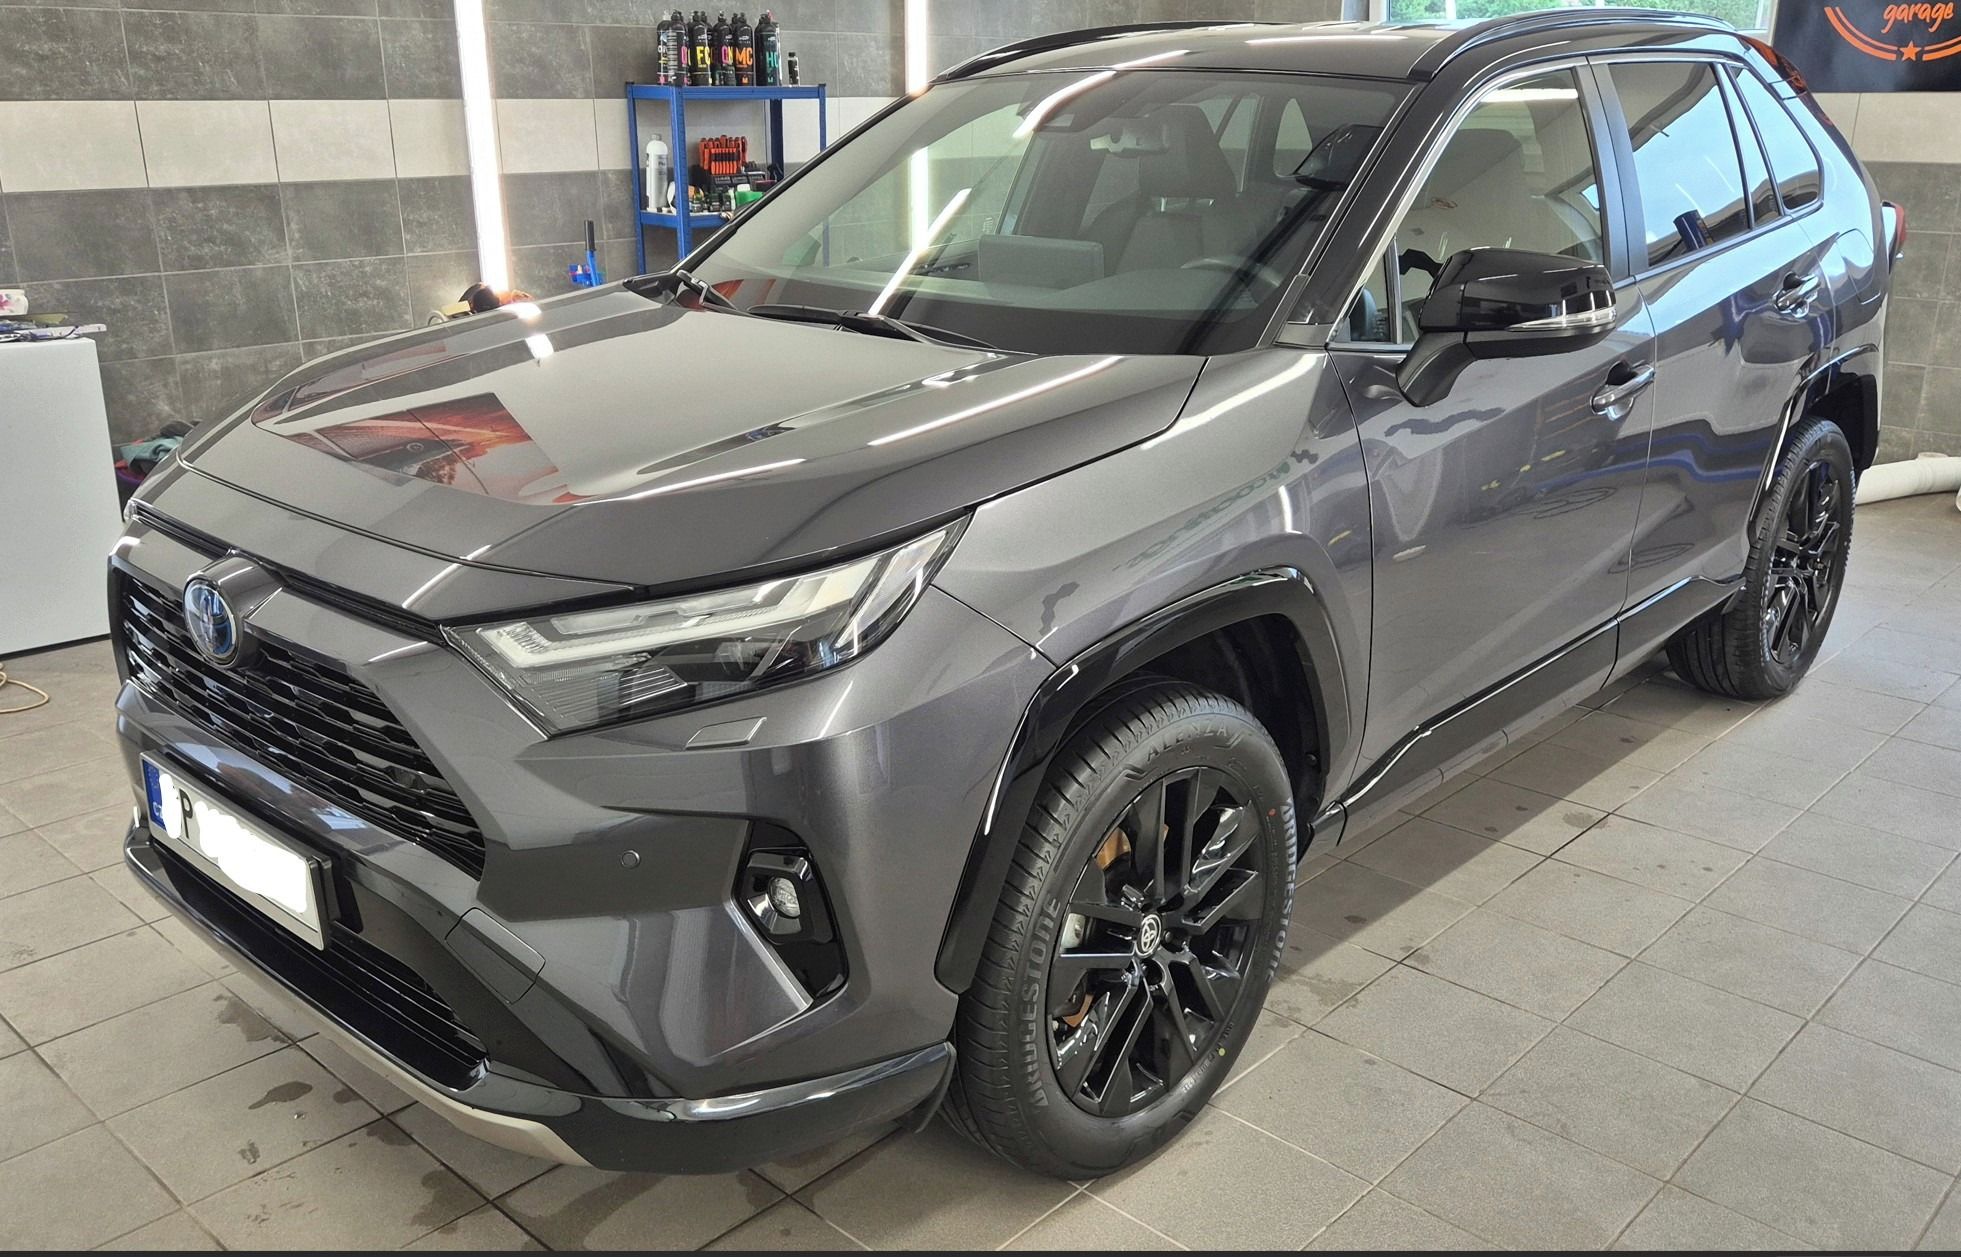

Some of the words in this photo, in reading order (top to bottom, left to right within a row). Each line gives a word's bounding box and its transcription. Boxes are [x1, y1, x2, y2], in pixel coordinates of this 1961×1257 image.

[1881, 2, 1954, 34] garage
[1147, 718, 1228, 761] ALENZA
[1022, 897, 1061, 1107] BRIDGESTONE
